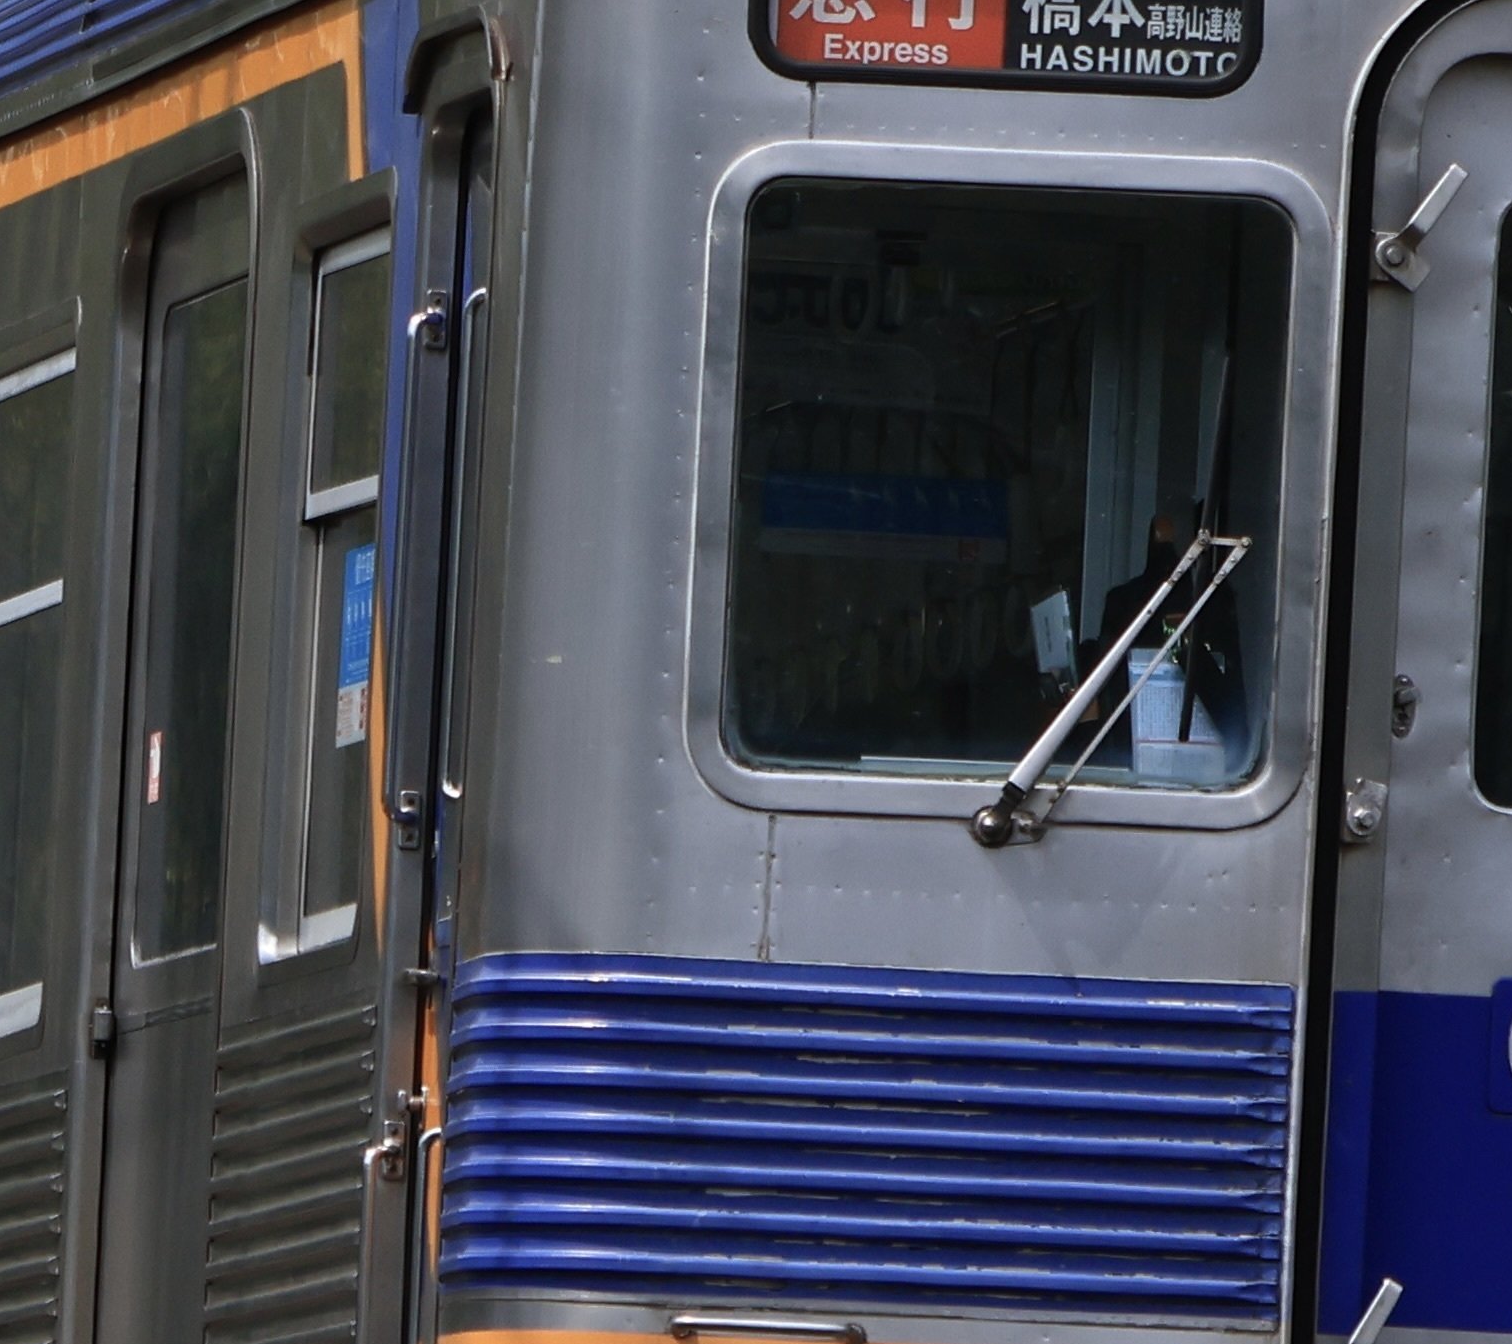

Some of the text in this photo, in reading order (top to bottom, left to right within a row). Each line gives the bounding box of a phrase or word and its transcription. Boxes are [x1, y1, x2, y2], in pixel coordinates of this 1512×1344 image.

[1147, 3, 1243, 44] 高野山連絡
[824, 33, 949, 65] Express
